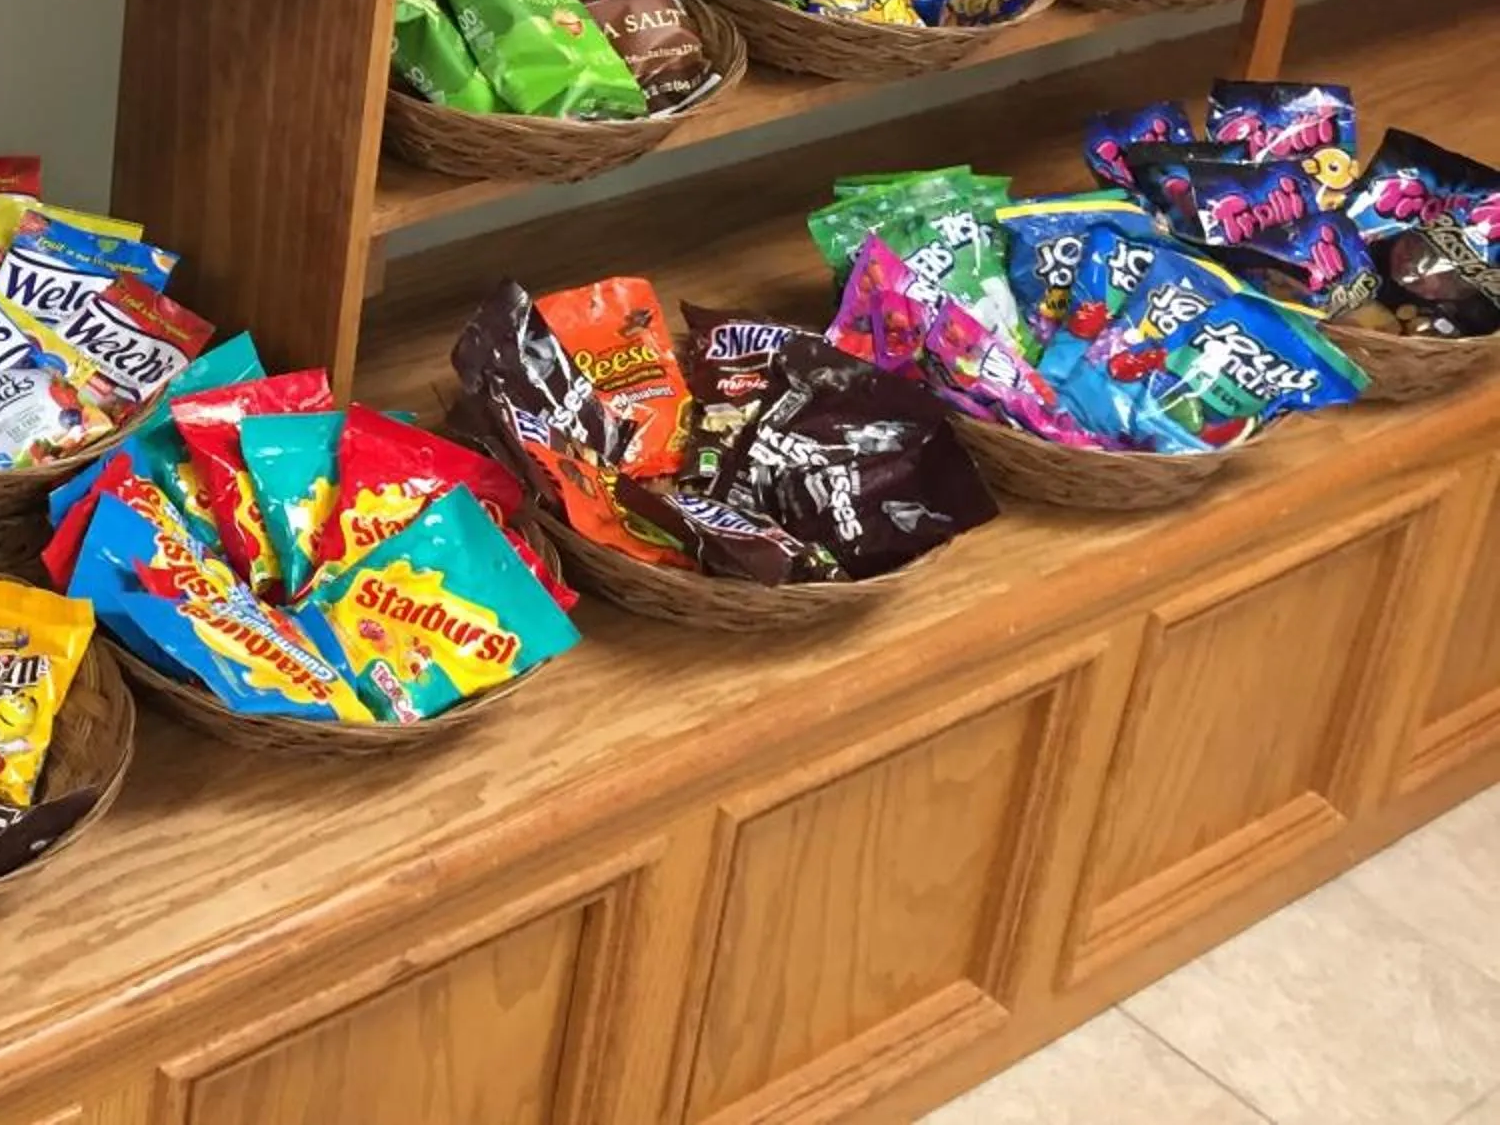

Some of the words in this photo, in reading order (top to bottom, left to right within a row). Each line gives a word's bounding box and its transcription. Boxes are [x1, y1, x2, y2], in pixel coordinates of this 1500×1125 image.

[624, 9, 682, 33] SALT
[1213, 177, 1304, 244] Trolli
[5, 262, 96, 315] Welc
[64, 308, 174, 384] Welch's
[711, 325, 791, 358] SNICK
[355, 578, 519, 664] Starburst
